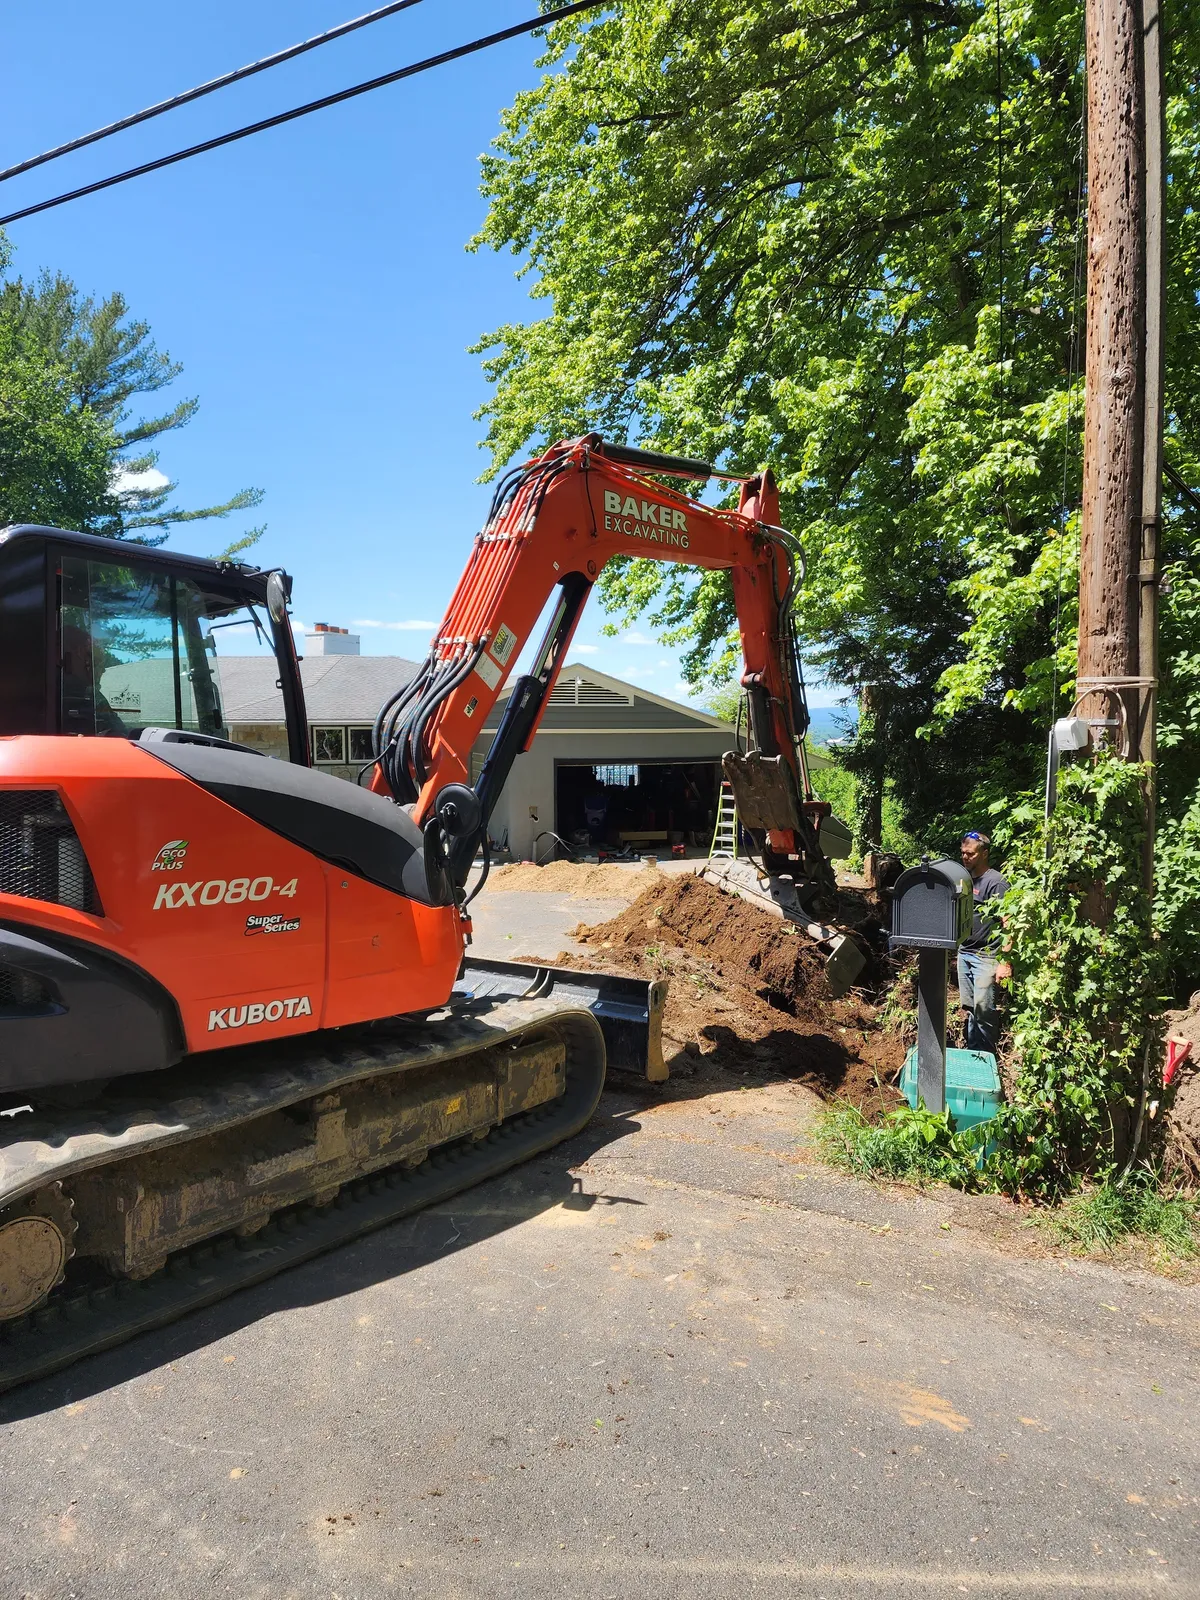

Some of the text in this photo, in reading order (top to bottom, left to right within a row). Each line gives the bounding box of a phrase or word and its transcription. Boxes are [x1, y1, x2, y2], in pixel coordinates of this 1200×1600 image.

[604, 490, 688, 532] BAKER
[604, 515, 690, 549] EXCAVATING
[161, 849, 186, 858] eco
[151, 861, 184, 871] PLUS
[153, 876, 299, 910] KX080-4
[247, 914, 283, 927] Super
[264, 921, 300, 933] Series
[207, 996, 312, 1032] KUBOTA
